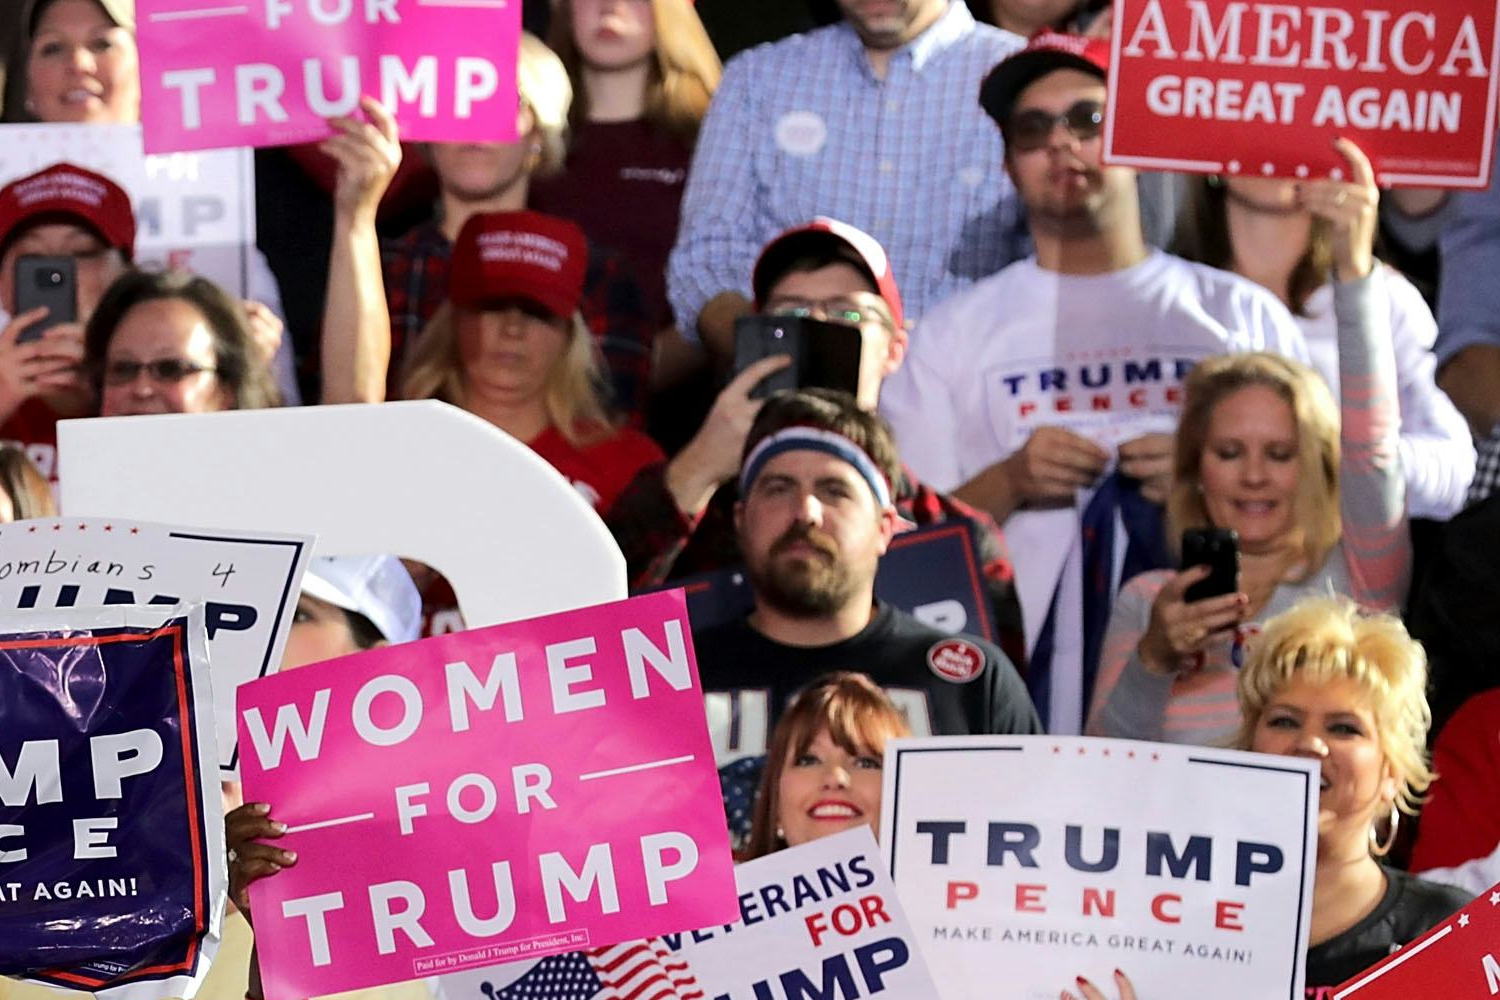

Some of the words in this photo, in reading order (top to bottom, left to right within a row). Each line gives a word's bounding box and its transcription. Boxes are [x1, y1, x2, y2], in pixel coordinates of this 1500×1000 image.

[1123, 0, 1488, 77] AMERICA
[162, 55, 497, 130] TRUMP
[1146, 75, 1305, 125] GREAT
[1312, 85, 1462, 133] AGAIN
[213, 562, 237, 588] 4
[242, 619, 693, 771] WOMEN
[395, 763, 558, 836] FOR
[916, 821, 1285, 887] TRUMP
[33, 877, 139, 901] AGAIN!
[282, 831, 699, 967] TRUMP
[660, 855, 875, 952] VERANS
[946, 881, 1246, 931] PENCE
[804, 894, 892, 947] FOR
[933, 926, 993, 942] MAKE
[1001, 928, 1099, 947] AMERICA
[1109, 934, 1176, 953] GREAT
[1184, 943, 1253, 965] AGAIN!
[417, 960, 434, 970] Paid
[435, 958, 446, 968] for
[459, 950, 486, 962] Donald
[493, 945, 518, 956] Trump
[520, 943, 531, 952] for
